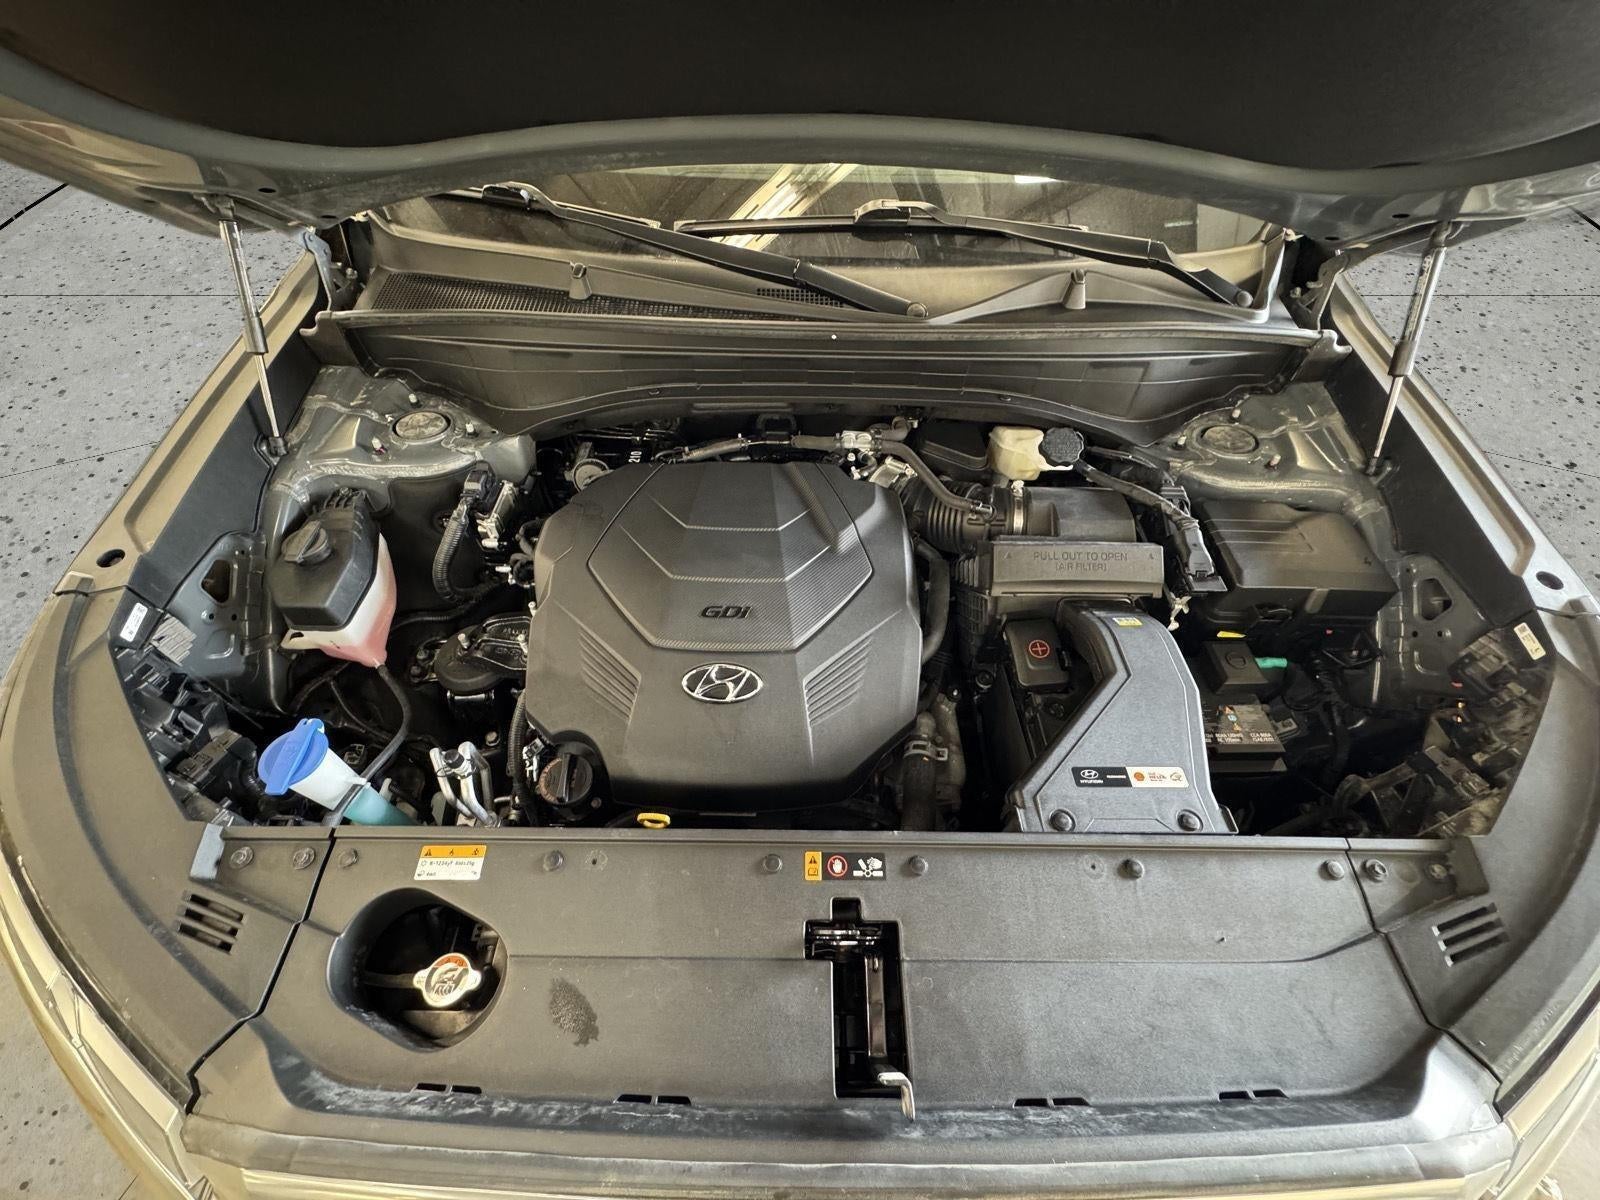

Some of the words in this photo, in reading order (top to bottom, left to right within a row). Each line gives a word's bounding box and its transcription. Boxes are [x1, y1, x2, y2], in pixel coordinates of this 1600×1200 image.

[1033, 551, 1059, 561] PULL
[1061, 551, 1081, 561] OUT
[1086, 551, 1098, 561] TO
[1100, 551, 1128, 561] OPEN
